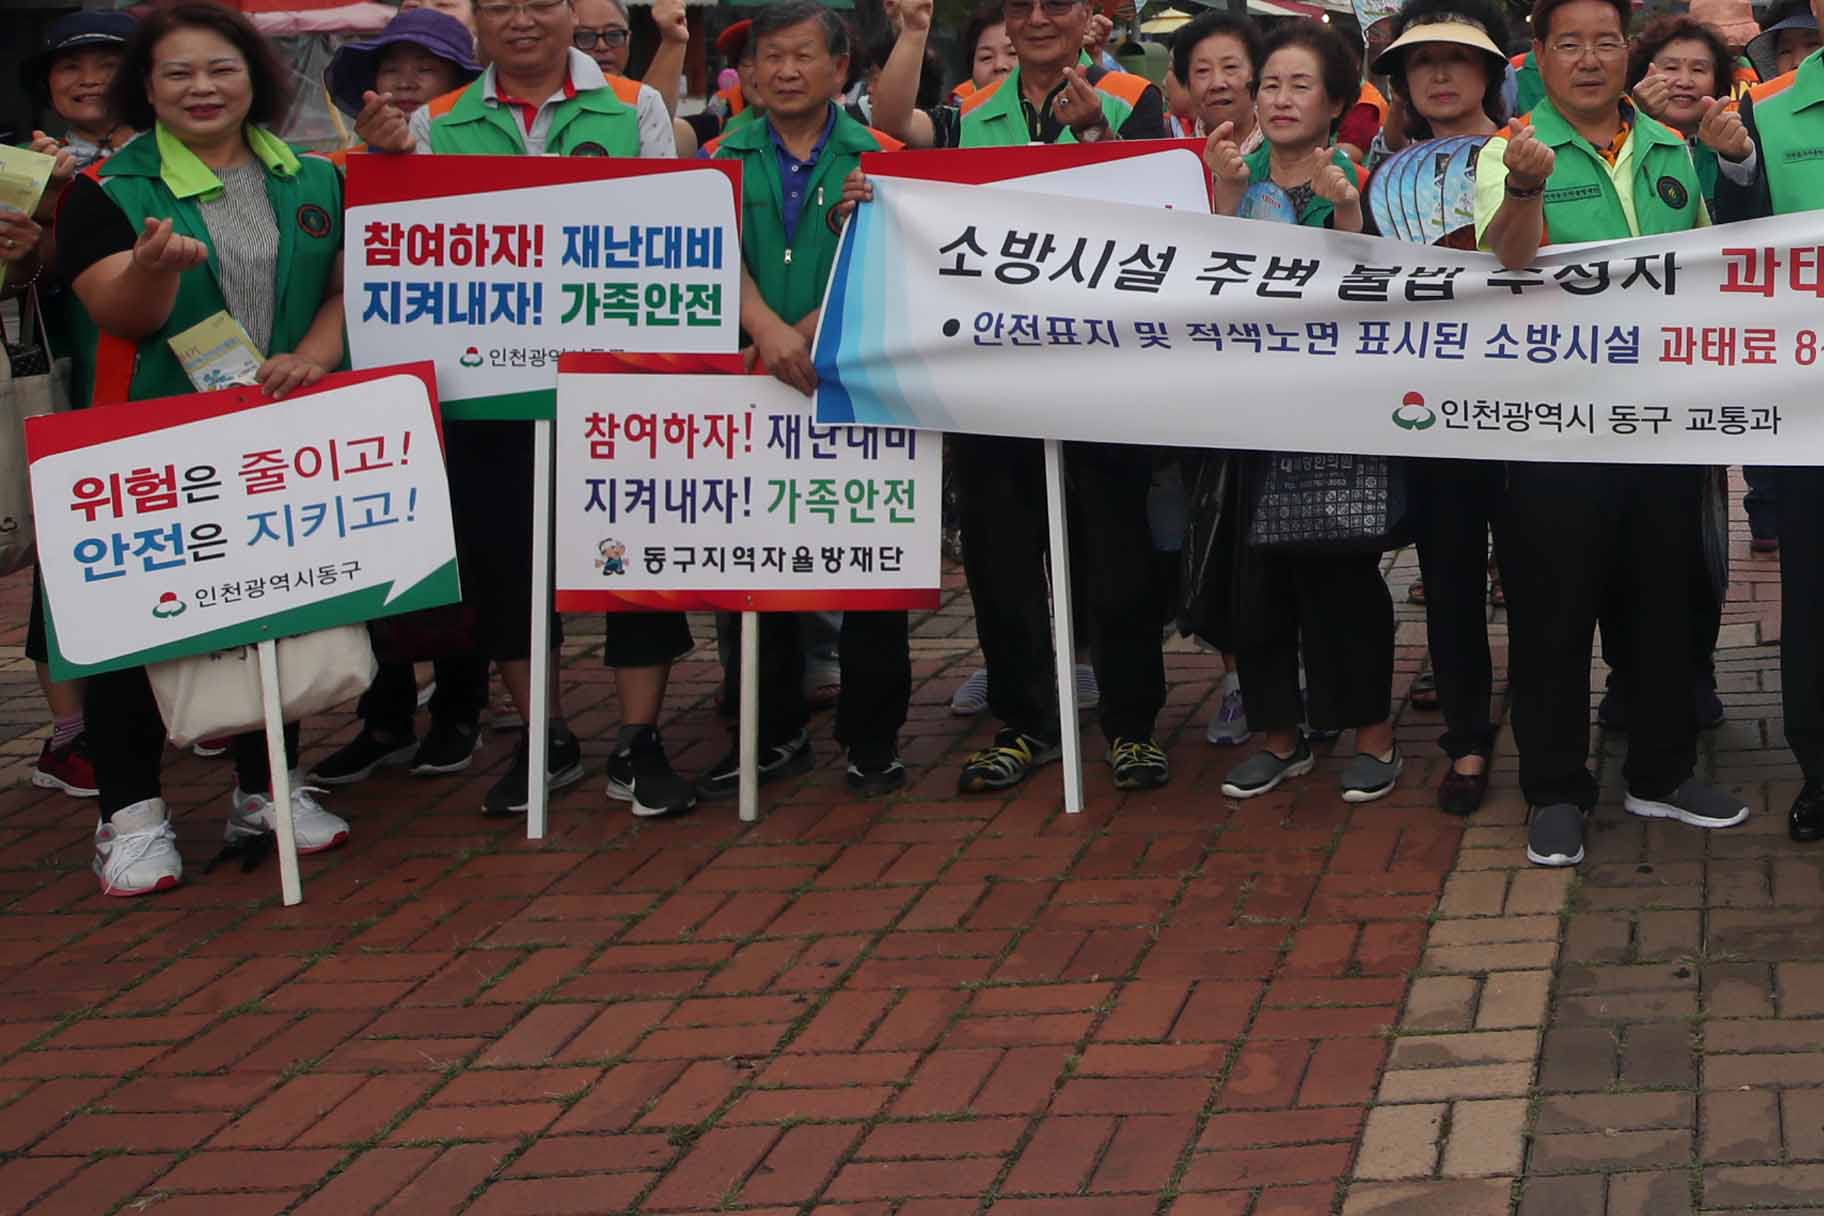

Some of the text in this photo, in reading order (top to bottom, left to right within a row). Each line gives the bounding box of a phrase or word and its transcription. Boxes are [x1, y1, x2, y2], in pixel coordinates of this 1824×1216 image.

[363, 222, 723, 270] 참여하자! 재난대비
[938, 226, 1176, 293] 소방시설
[1196, 251, 1320, 299] 주변
[362, 281, 722, 326] 지켜내자! 가족안전
[973, 311, 1120, 349] 안전표지
[1134, 321, 1172, 349] 및
[1186, 320, 1339, 356] 적색노면
[1355, 320, 1469, 361] 표시된
[1484, 323, 1641, 364] 소방시설
[1658, 326, 1777, 367] 과태료
[584, 410, 753, 461] 참여하자!
[1440, 399, 1782, 436] 인천광역시 동구 교통과
[70, 431, 411, 523] 위험은 줄이고!
[583, 476, 916, 525] 지켜내자! 가족안전
[73, 487, 418, 584] 안전은 지키고!
[643, 545, 904, 574] 동구지역자율방재단
[195, 560, 363, 608] 인천광역시동구
